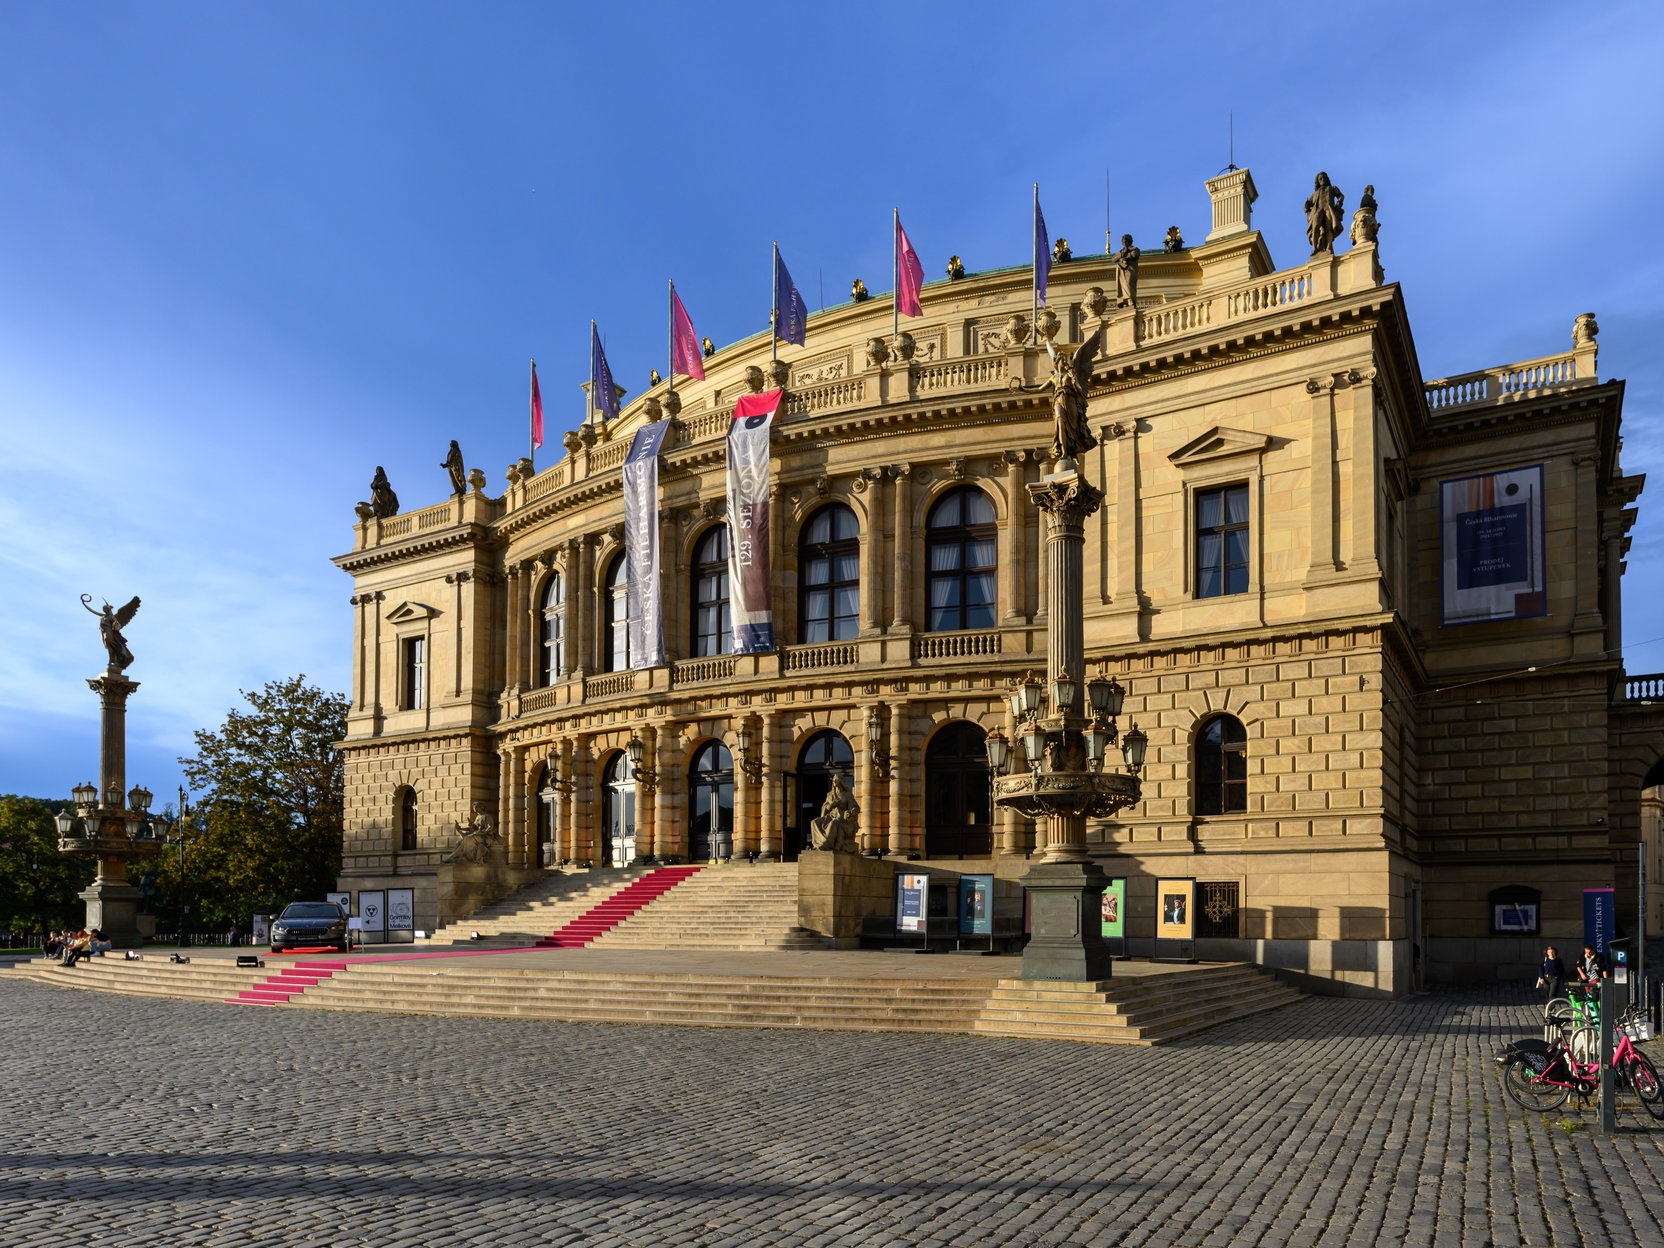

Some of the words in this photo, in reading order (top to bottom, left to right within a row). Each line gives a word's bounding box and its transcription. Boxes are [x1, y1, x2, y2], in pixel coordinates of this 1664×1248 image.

[636, 434, 655, 566] FILHARMONIE
[739, 450, 754, 529] SEZONA
[739, 535, 752, 568] 129.
[1473, 563, 1511, 571] VSTUPENEK
[1480, 557, 1504, 565] PRODEJ
[640, 572, 653, 635] ČESKÁ
[1618, 951, 1625, 961] P
